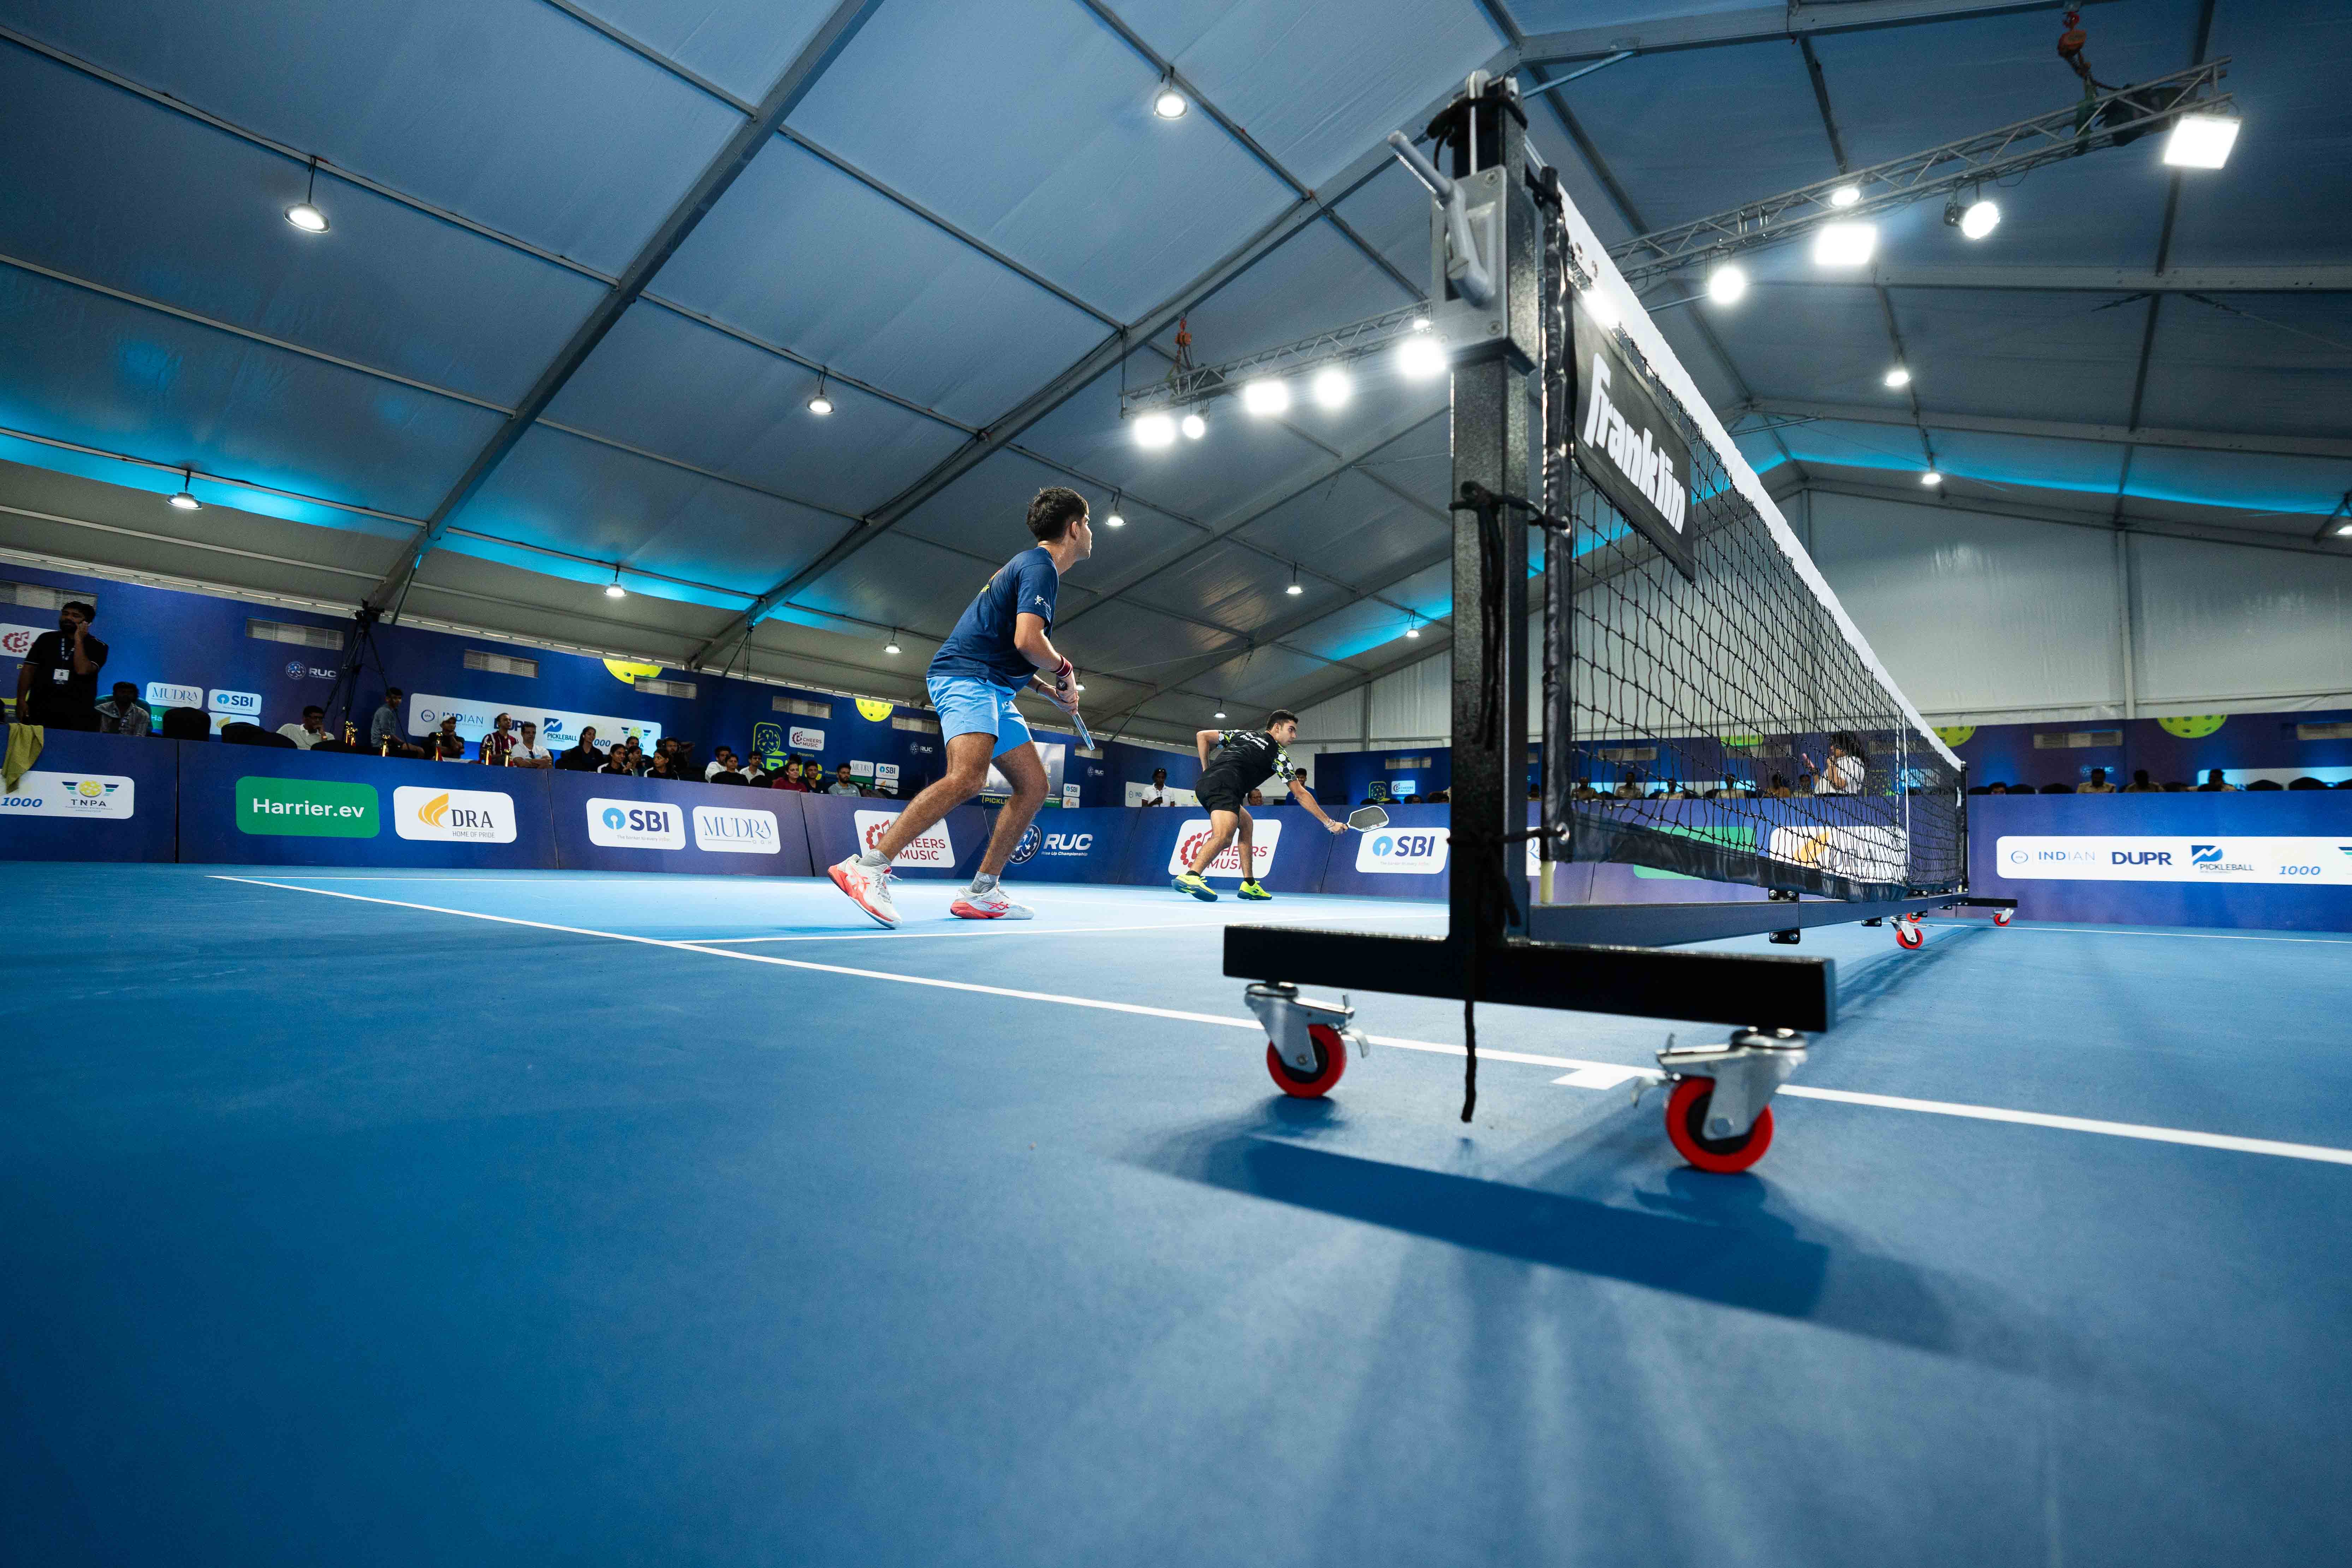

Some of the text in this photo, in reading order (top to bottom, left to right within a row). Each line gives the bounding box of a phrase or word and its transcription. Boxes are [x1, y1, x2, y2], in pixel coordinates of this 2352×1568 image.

[1584, 353, 1685, 534] Franklin
[309, 668, 337, 678] RUC
[153, 687, 197, 701] MUDRA
[231, 695, 253, 707] SBI
[547, 733, 577, 741] PICKLEBALL
[1, 797, 42, 808] 1000
[254, 798, 364, 818] Harrier.ev
[451, 809, 494, 828] DRA
[629, 809, 669, 832] SBI
[703, 816, 771, 839] MUDRA
[906, 838, 945, 848] EERS
[1043, 834, 1093, 850] RUC
[1395, 836, 1435, 857] SBI
[900, 850, 939, 860] MUSIC
[1220, 846, 1268, 857] HERS
[2039, 851, 2095, 860] INDIAN
[2112, 852, 2173, 865] DUPR
[2279, 866, 2321, 875] 1000
